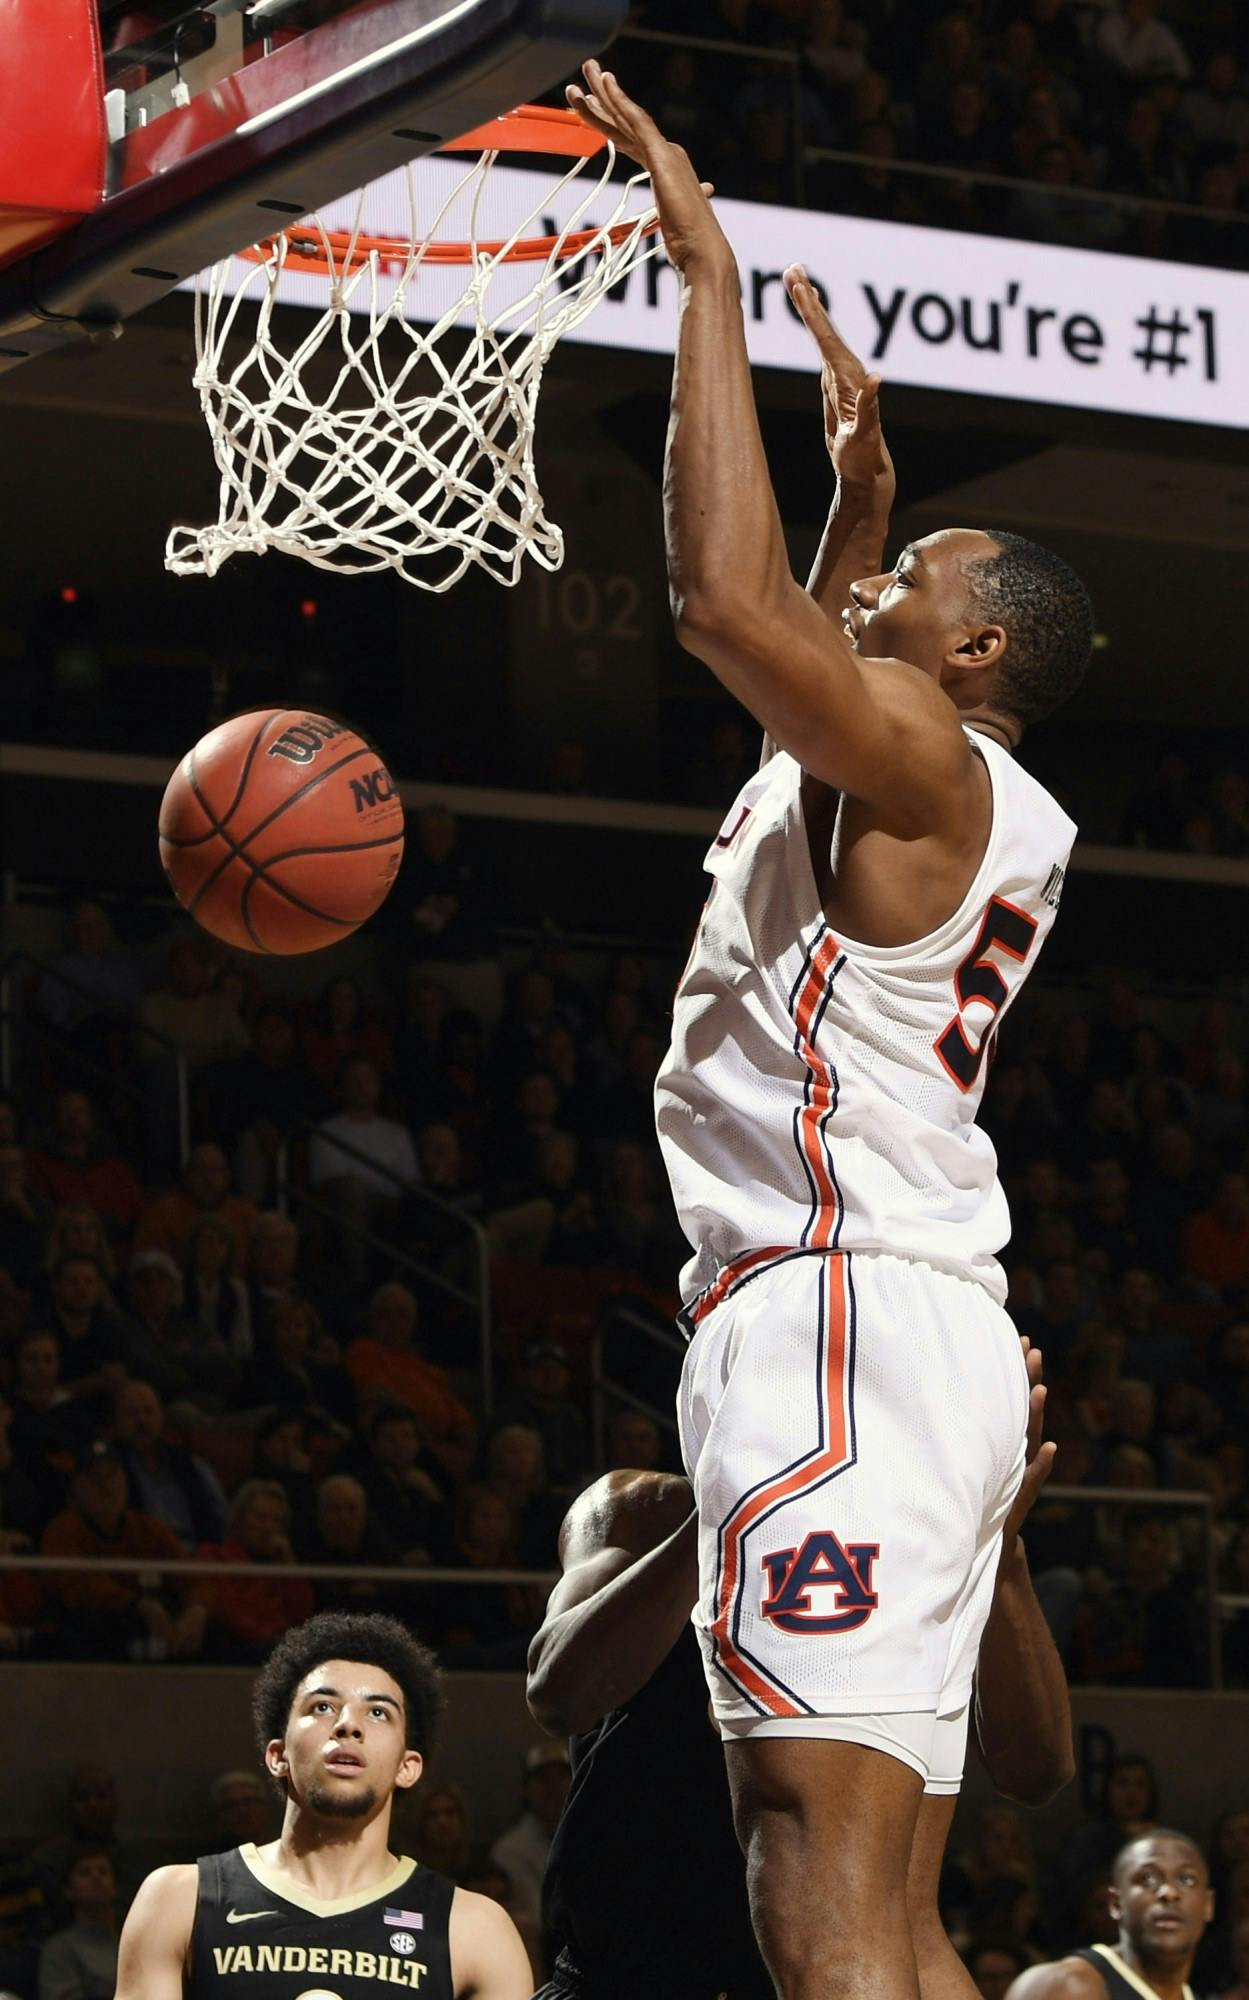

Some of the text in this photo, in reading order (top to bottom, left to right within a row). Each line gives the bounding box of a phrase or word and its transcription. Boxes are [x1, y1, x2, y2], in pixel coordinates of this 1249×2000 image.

[542, 216, 1218, 382] Whre you're #1
[532, 567, 642, 640] 102
[213, 1945, 428, 1989] VANDERBILT
[391, 1933, 415, 1953] SEC
